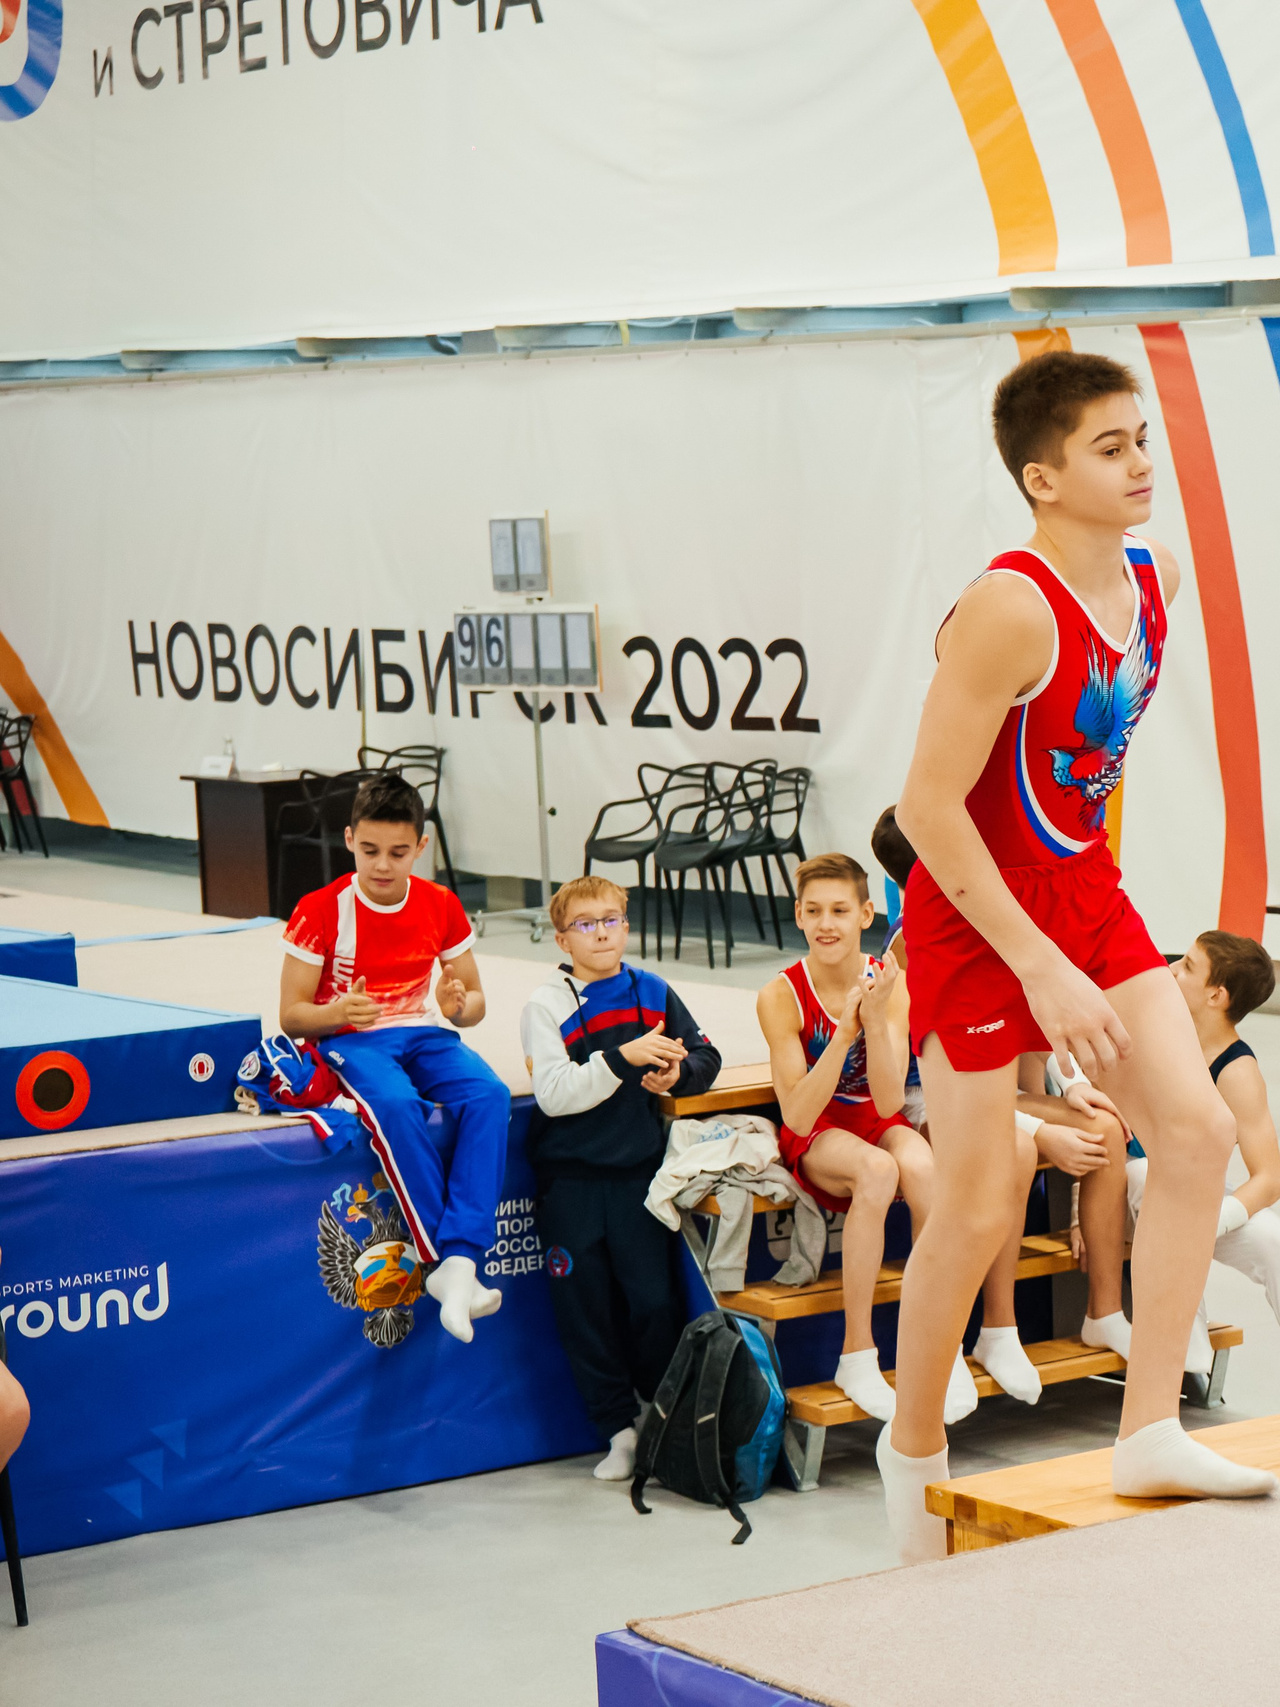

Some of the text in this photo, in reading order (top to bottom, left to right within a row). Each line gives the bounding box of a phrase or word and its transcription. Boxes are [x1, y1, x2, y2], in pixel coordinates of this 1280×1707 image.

[457, 616, 505, 668] 96
[127, 620, 821, 733] НОВОСИБИ 2022
[496, 1217, 534, 1237] ПОР
[0, 1265, 149, 1297] PORTS MARKETING
